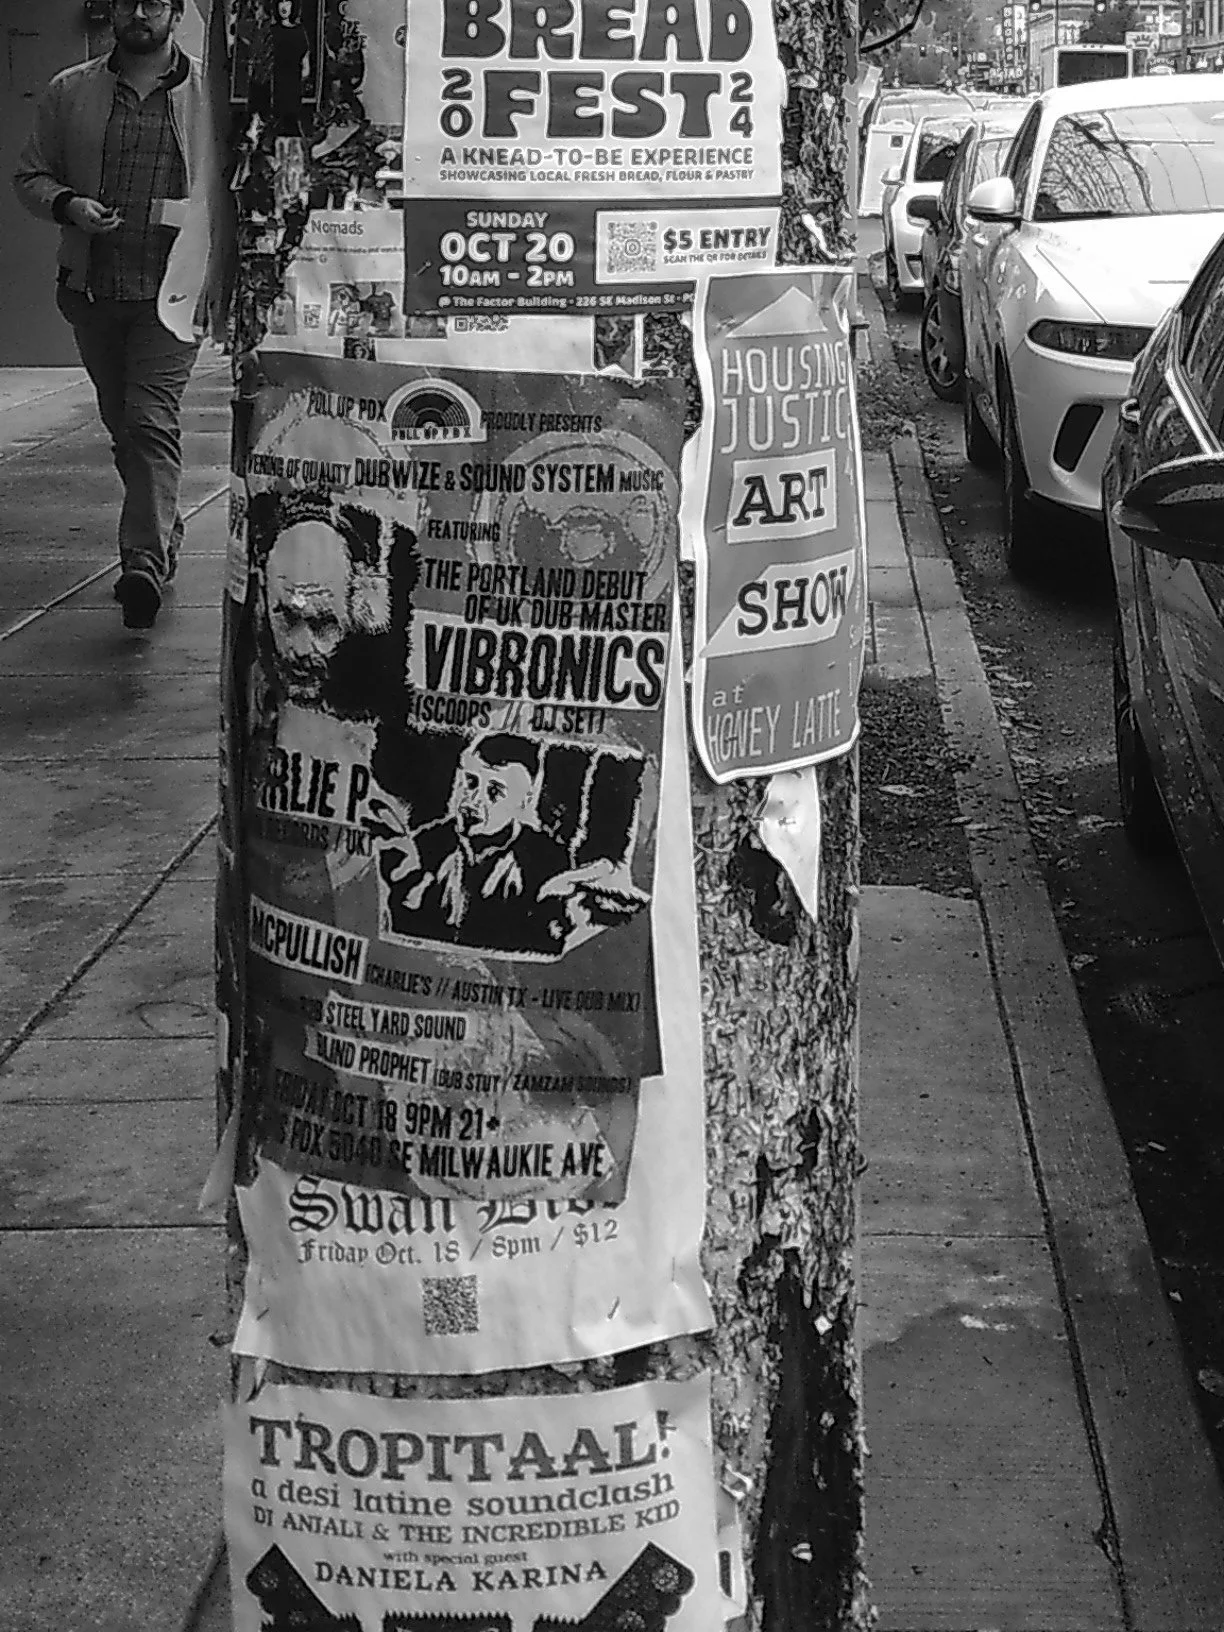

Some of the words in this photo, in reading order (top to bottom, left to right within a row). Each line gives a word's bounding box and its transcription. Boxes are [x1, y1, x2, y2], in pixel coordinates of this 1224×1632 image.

[482, 70, 721, 138] FEST
[440, 170, 526, 182] SHOWCASING
[530, 170, 571, 182] LOCAL
[575, 170, 615, 182] FRESH
[619, 170, 662, 183] BREAD,
[666, 170, 701, 181] FLOUR
[716, 169, 753, 180] PASTRY
[441, 148, 456, 166] A
[462, 148, 623, 166] KNEAD-TO-BE
[631, 148, 754, 166] EXPERIENCE
[311, 219, 363, 236] Nomads
[466, 211, 548, 229] SUNDAY
[440, 232, 516, 262] OCT
[526, 232, 575, 263] 20
[663, 228, 692, 253] $5
[700, 227, 771, 249] ENTRY
[453, 296, 474, 307] The
[517, 297, 567, 309] Building
[615, 295, 661, 306] Madison
[721, 342, 847, 396] HOUSING
[359, 398, 387, 421] PDX
[482, 410, 535, 431] PROUDLY
[540, 414, 602, 433] PRESENTS
[720, 387, 848, 454] JUSTIC
[355, 458, 440, 490] DUBWIZE
[444, 470, 456, 491] &
[460, 463, 526, 492] SOUND
[532, 463, 615, 493] SYSTEM
[619, 470, 664, 492] MUSIC
[733, 466, 828, 526] ART
[427, 519, 500, 542] FEATURING
[424, 558, 462, 592] THE
[467, 562, 576, 599] PORTLAND
[582, 570, 647, 600] DEBUT
[465, 594, 489, 624] OF
[497, 596, 523, 626] UK
[531, 599, 573, 629] DUB
[580, 601, 666, 632] MASTER
[737, 566, 848, 637] SHOW
[425, 623, 665, 706] VIBRONICS
[712, 684, 744, 707] at
[708, 704, 781, 764] HONEY
[793, 689, 841, 749] LATTE
[253, 905, 362, 979] MCPULLISH
[452, 980, 503, 1006] AUSTIN
[508, 986, 526, 1008] TX
[542, 988, 571, 1009] LIVE
[326, 1001, 366, 1031] STEEL
[371, 1008, 410, 1036] YARD
[414, 1014, 466, 1041] SOUND
[359, 1045, 432, 1085] PROPHET
[405, 1102, 451, 1139] 9PM
[458, 1107, 500, 1142] 21+
[419, 1142, 553, 1179] MILWAUKIE
[561, 1141, 605, 1178] AVE
[289, 1175, 456, 1236] Swan
[298, 1240, 369, 1265] Friday
[375, 1241, 422, 1265] Oct.
[433, 1241, 460, 1263] 18
[492, 1235, 541, 1260] 8pm
[573, 1219, 618, 1247] $12
[249, 1410, 677, 1482] TROPITAAL!
[250, 1478, 267, 1499] a
[278, 1478, 341, 1509] desi
[353, 1489, 453, 1516] latine
[466, 1473, 675, 1517] soundclash
[372, 1523, 389, 1541] &
[399, 1523, 453, 1544] THE
[462, 1509, 625, 1543] INCREDIBLE
[635, 1499, 681, 1529] KID
[314, 1561, 457, 1592] DANIELA
[472, 1561, 608, 1592] KARINA
[383, 1551, 420, 1563] with
[424, 1551, 479, 1567] special
[483, 1550, 528, 1565] guest
